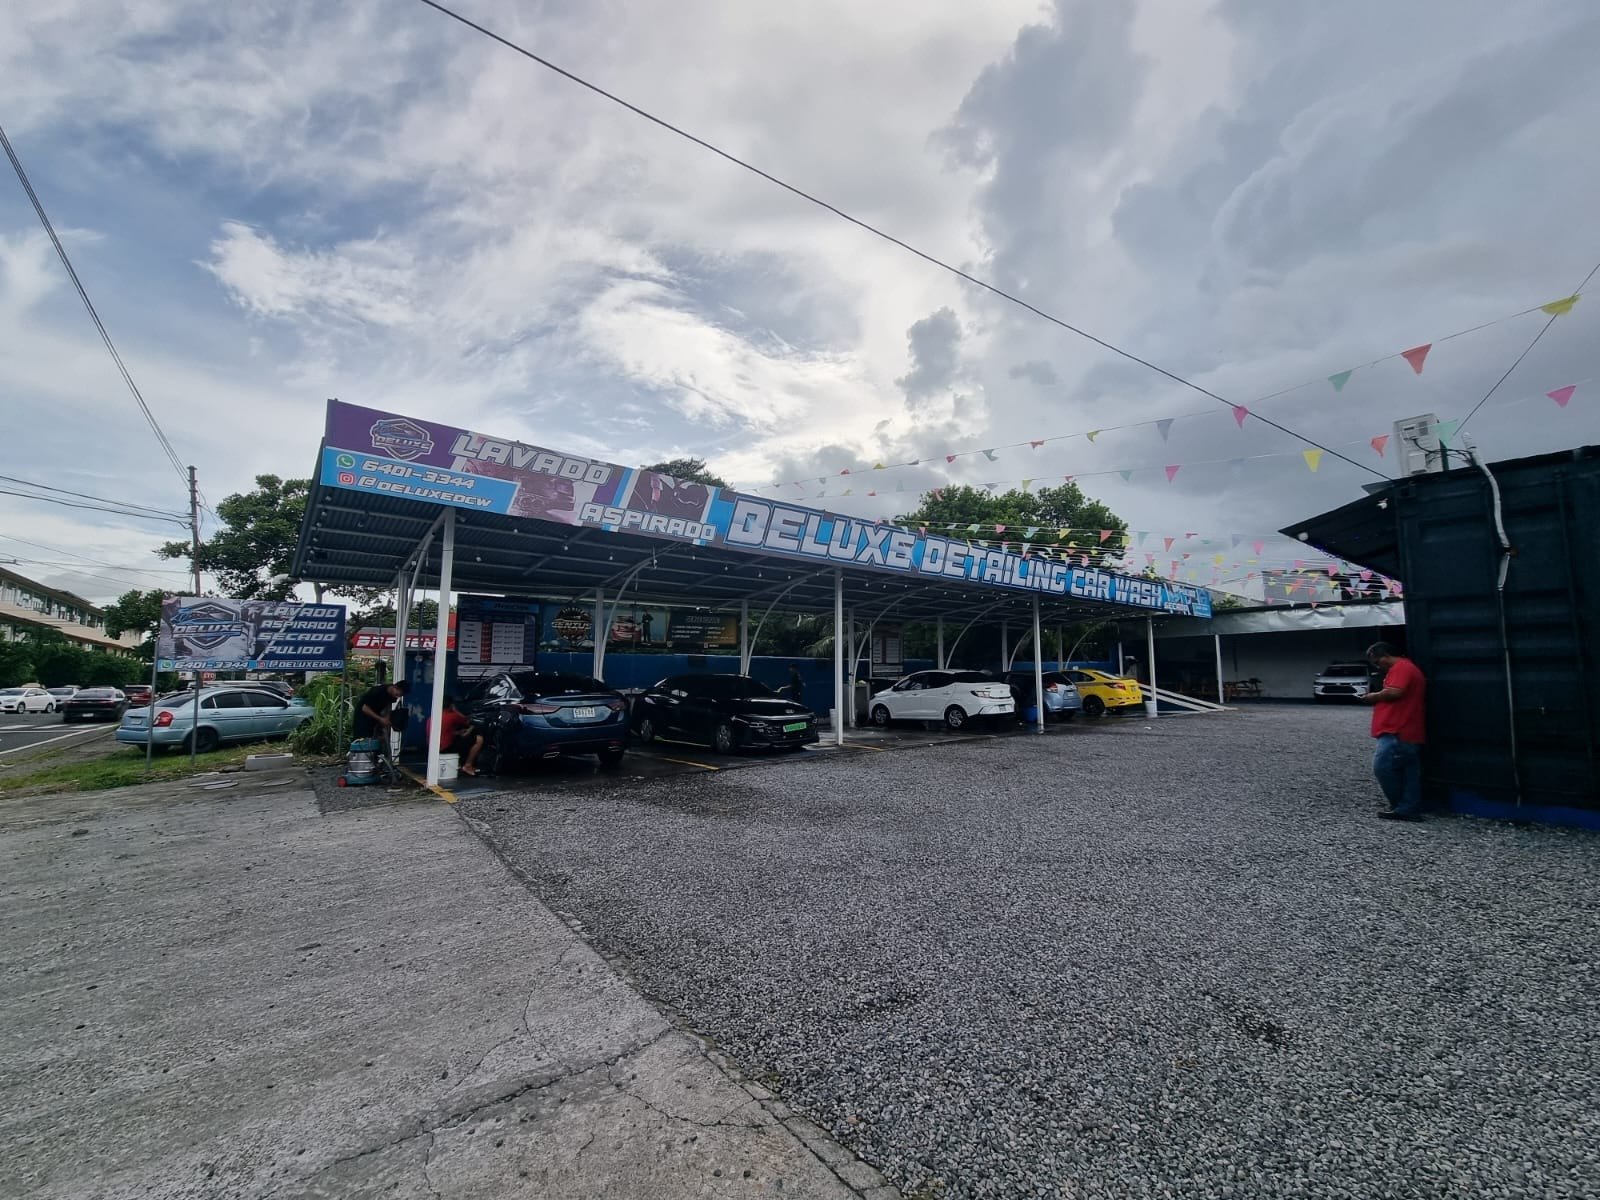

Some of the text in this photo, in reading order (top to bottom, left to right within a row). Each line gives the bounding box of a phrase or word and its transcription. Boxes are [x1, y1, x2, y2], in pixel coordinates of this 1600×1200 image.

[450, 433, 613, 486] LAVADO
[361, 459, 475, 489] 6401-3344
[578, 502, 717, 542] ASPIRADO
[724, 496, 1163, 608] DELUXE DETAILING CAR WASH
[260, 606, 340, 618] LAVADO
[173, 622, 245, 634] DELUXE
[260, 620, 337, 630] ASPIRADO
[257, 632, 338, 642] SECADO
[264, 646, 325, 655] PULIDO
[174, 661, 250, 669] 6401-3344
